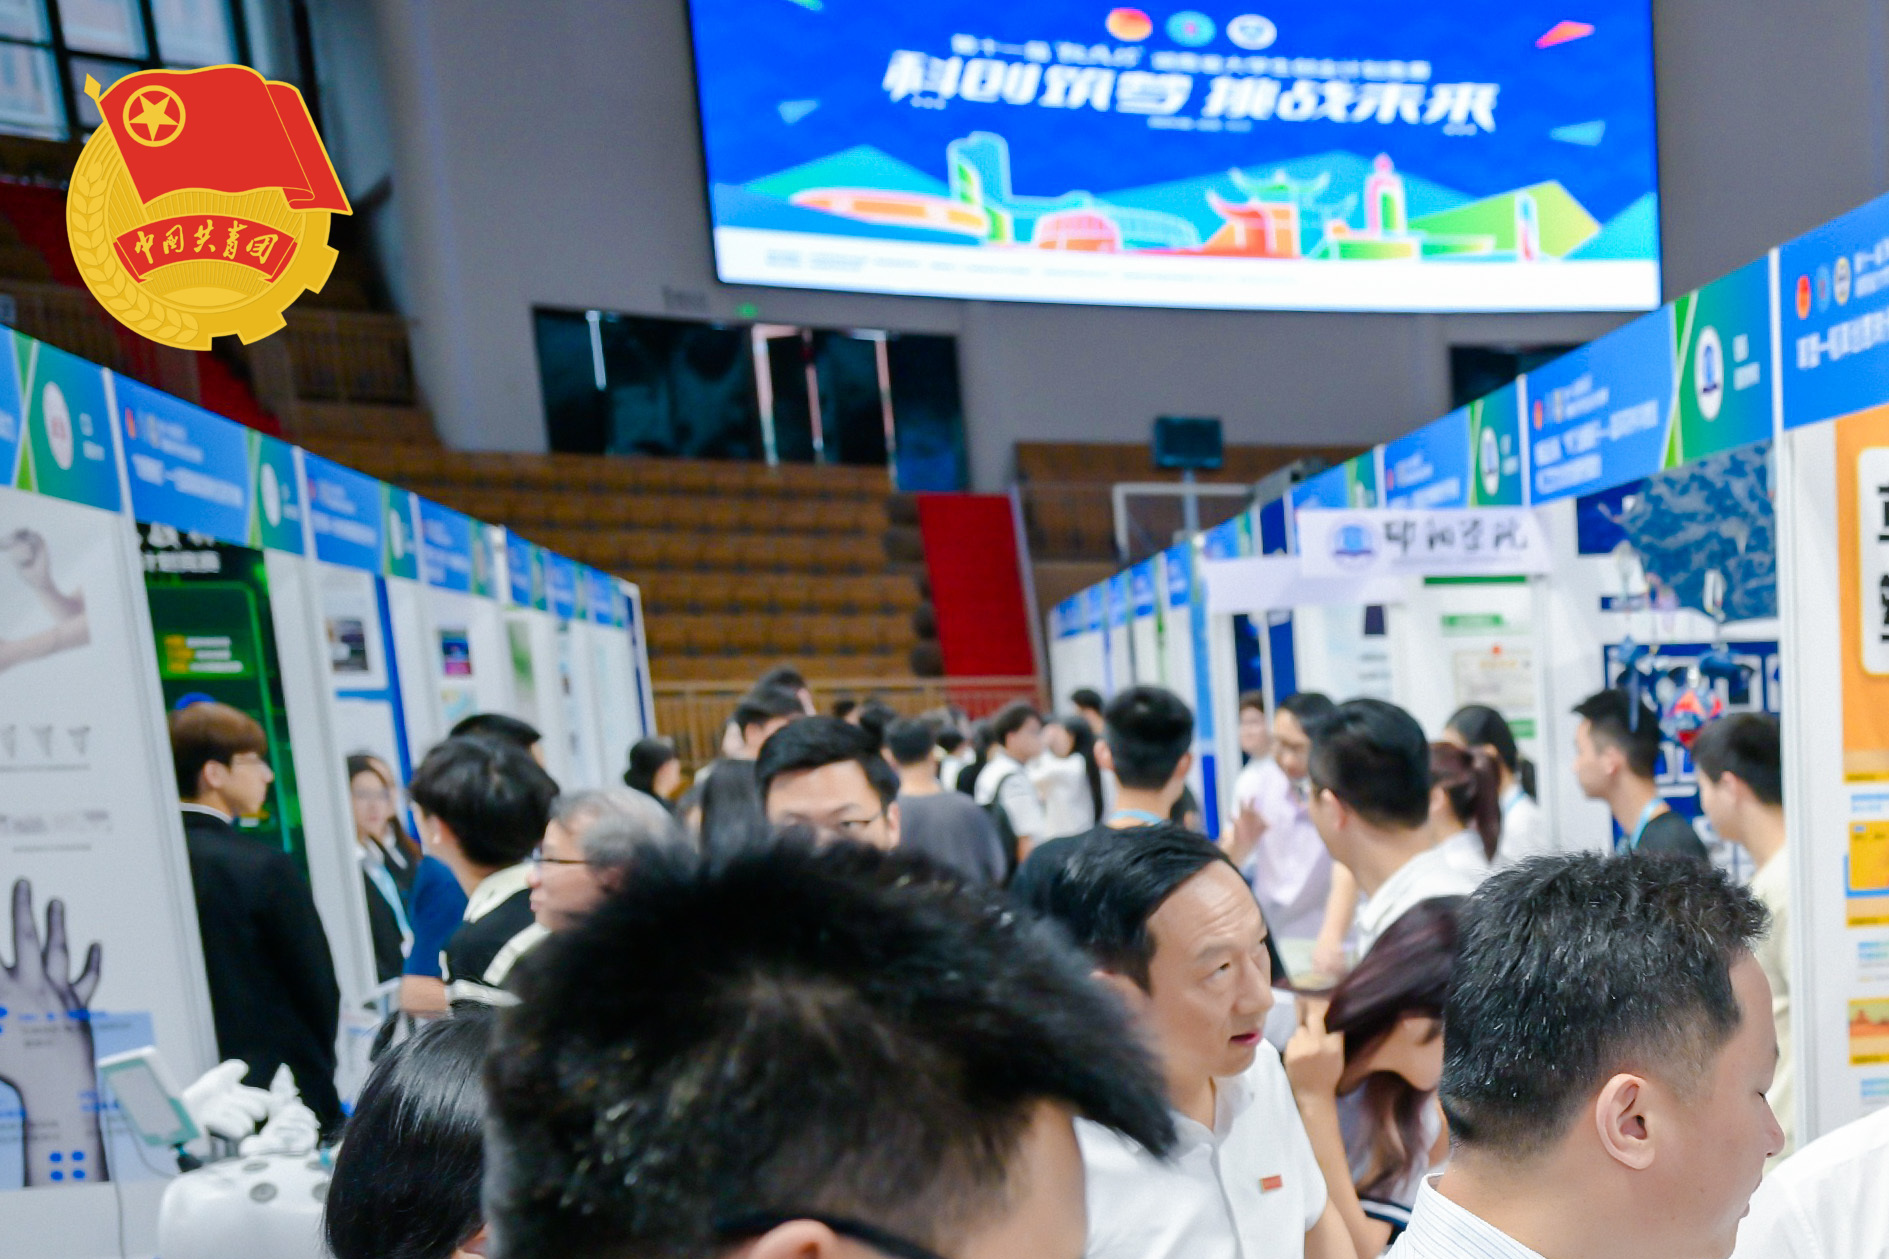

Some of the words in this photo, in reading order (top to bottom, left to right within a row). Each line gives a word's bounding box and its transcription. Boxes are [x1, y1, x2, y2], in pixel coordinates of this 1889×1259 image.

[882, 49, 1193, 116] 科创筑梦
[1202, 77, 1499, 132] 挑战未来
